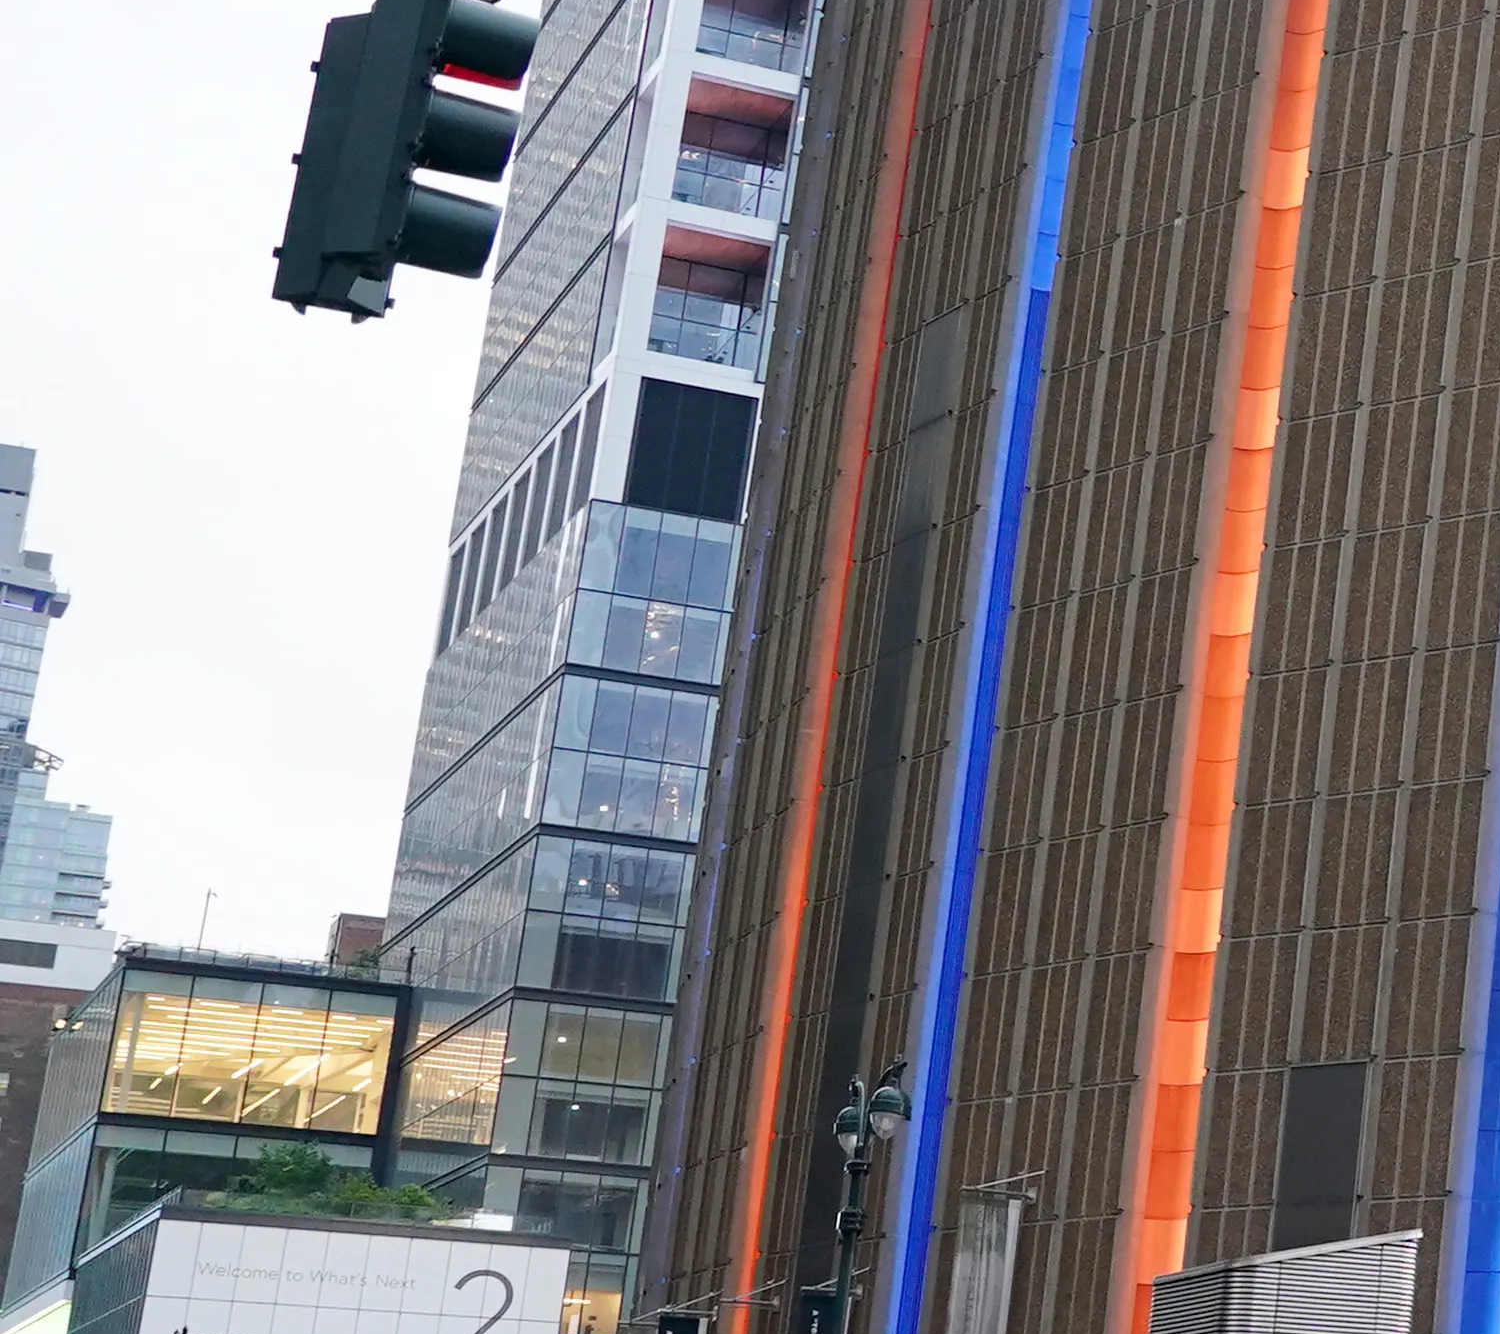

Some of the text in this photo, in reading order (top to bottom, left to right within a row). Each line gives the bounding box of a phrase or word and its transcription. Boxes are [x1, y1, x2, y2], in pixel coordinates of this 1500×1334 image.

[198, 1261, 417, 1291] Welcome to What's Next
